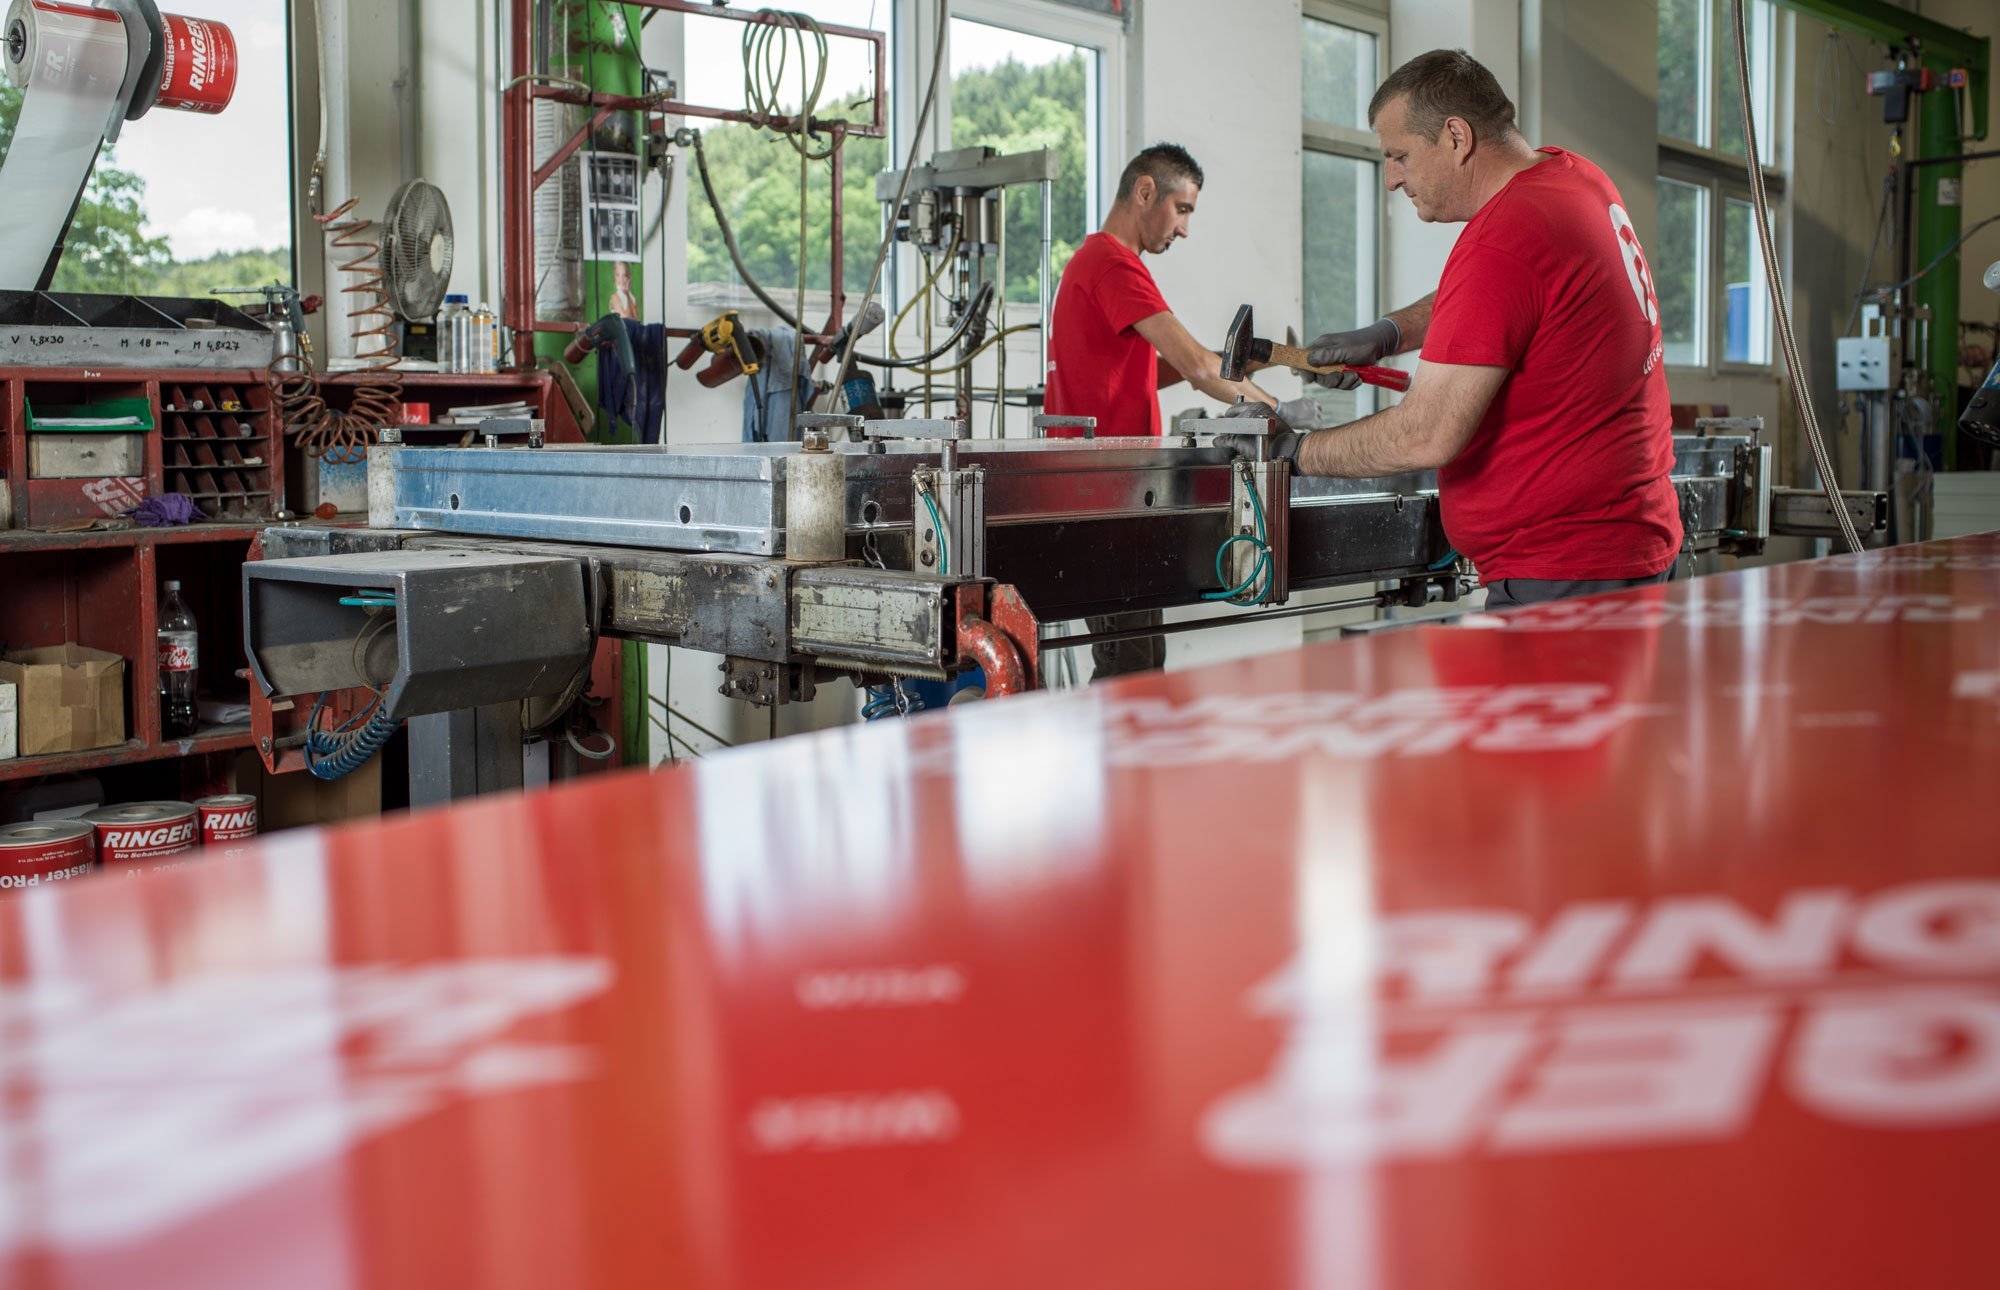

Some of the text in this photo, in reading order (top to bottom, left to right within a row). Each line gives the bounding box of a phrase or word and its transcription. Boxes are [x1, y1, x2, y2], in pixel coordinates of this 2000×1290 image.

[183, 17, 207, 91] RINGER
[139, 338, 151, 348] 18
[103, 822, 194, 848] RINGER
